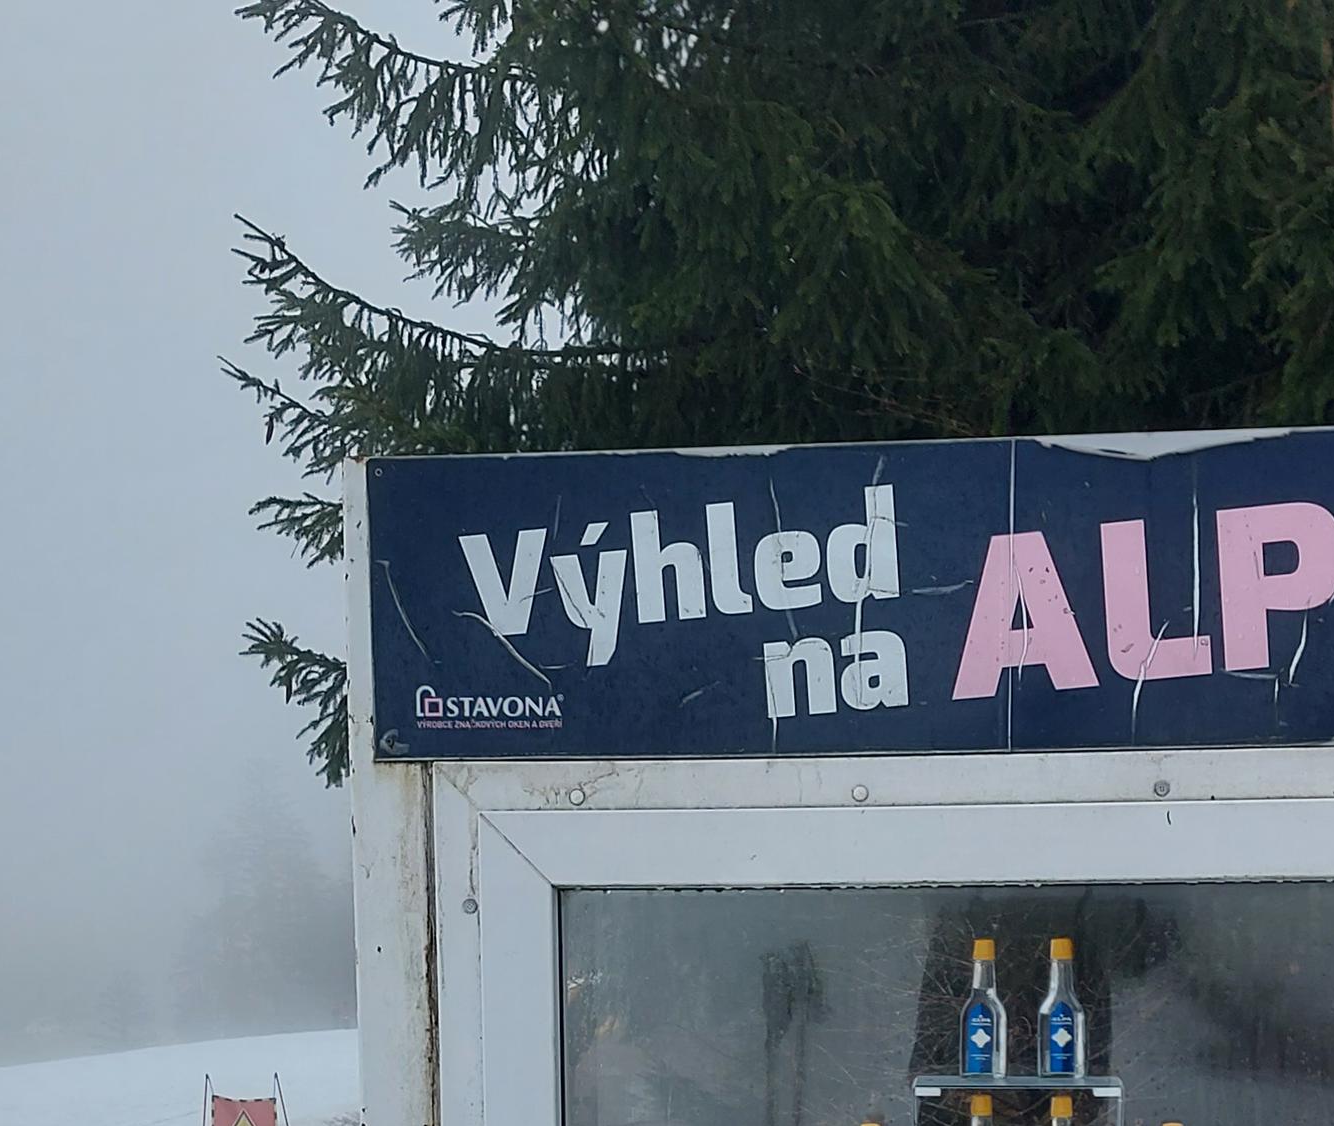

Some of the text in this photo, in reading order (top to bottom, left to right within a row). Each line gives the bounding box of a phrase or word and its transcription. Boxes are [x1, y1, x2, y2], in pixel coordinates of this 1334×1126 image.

[458, 484, 899, 669] Výhled
[763, 630, 910, 719] na
[508, 719, 530, 729] OKEN
[531, 720, 538, 728] A
